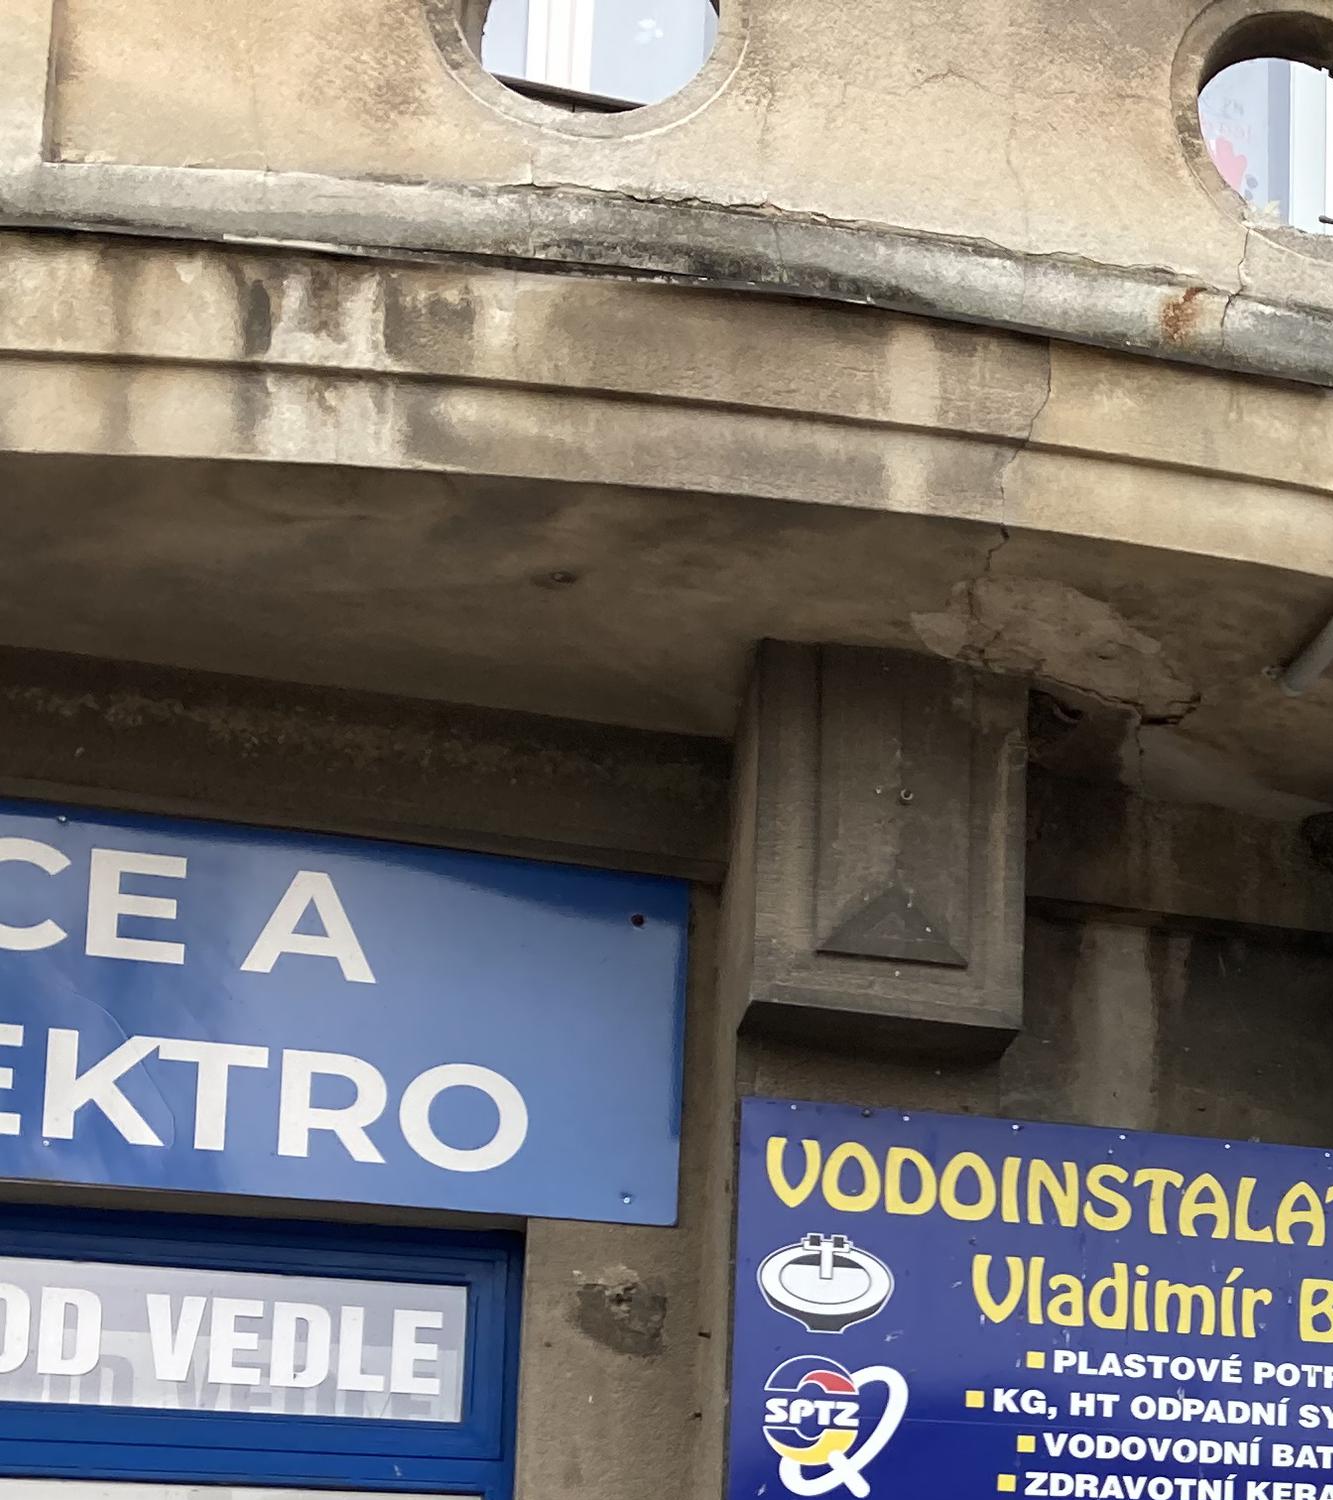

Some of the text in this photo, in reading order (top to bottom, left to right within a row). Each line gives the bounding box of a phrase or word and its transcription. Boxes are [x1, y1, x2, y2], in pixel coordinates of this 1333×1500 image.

[240, 870, 376, 984] A
[0, 1023, 528, 1172] KTRO
[973, 1255, 1272, 1338] Vladimír
[146, 1293, 443, 1396] VEDLE
[1053, 1349, 1243, 1385] PLASTOVÉ
[764, 1398, 860, 1428] SPTZ
[992, 1388, 1058, 1420] KG,
[1069, 1392, 1120, 1418] HT
[1130, 1396, 1288, 1428] ODPADNÍ
[1043, 1432, 1260, 1465] VODOVODNÍ
